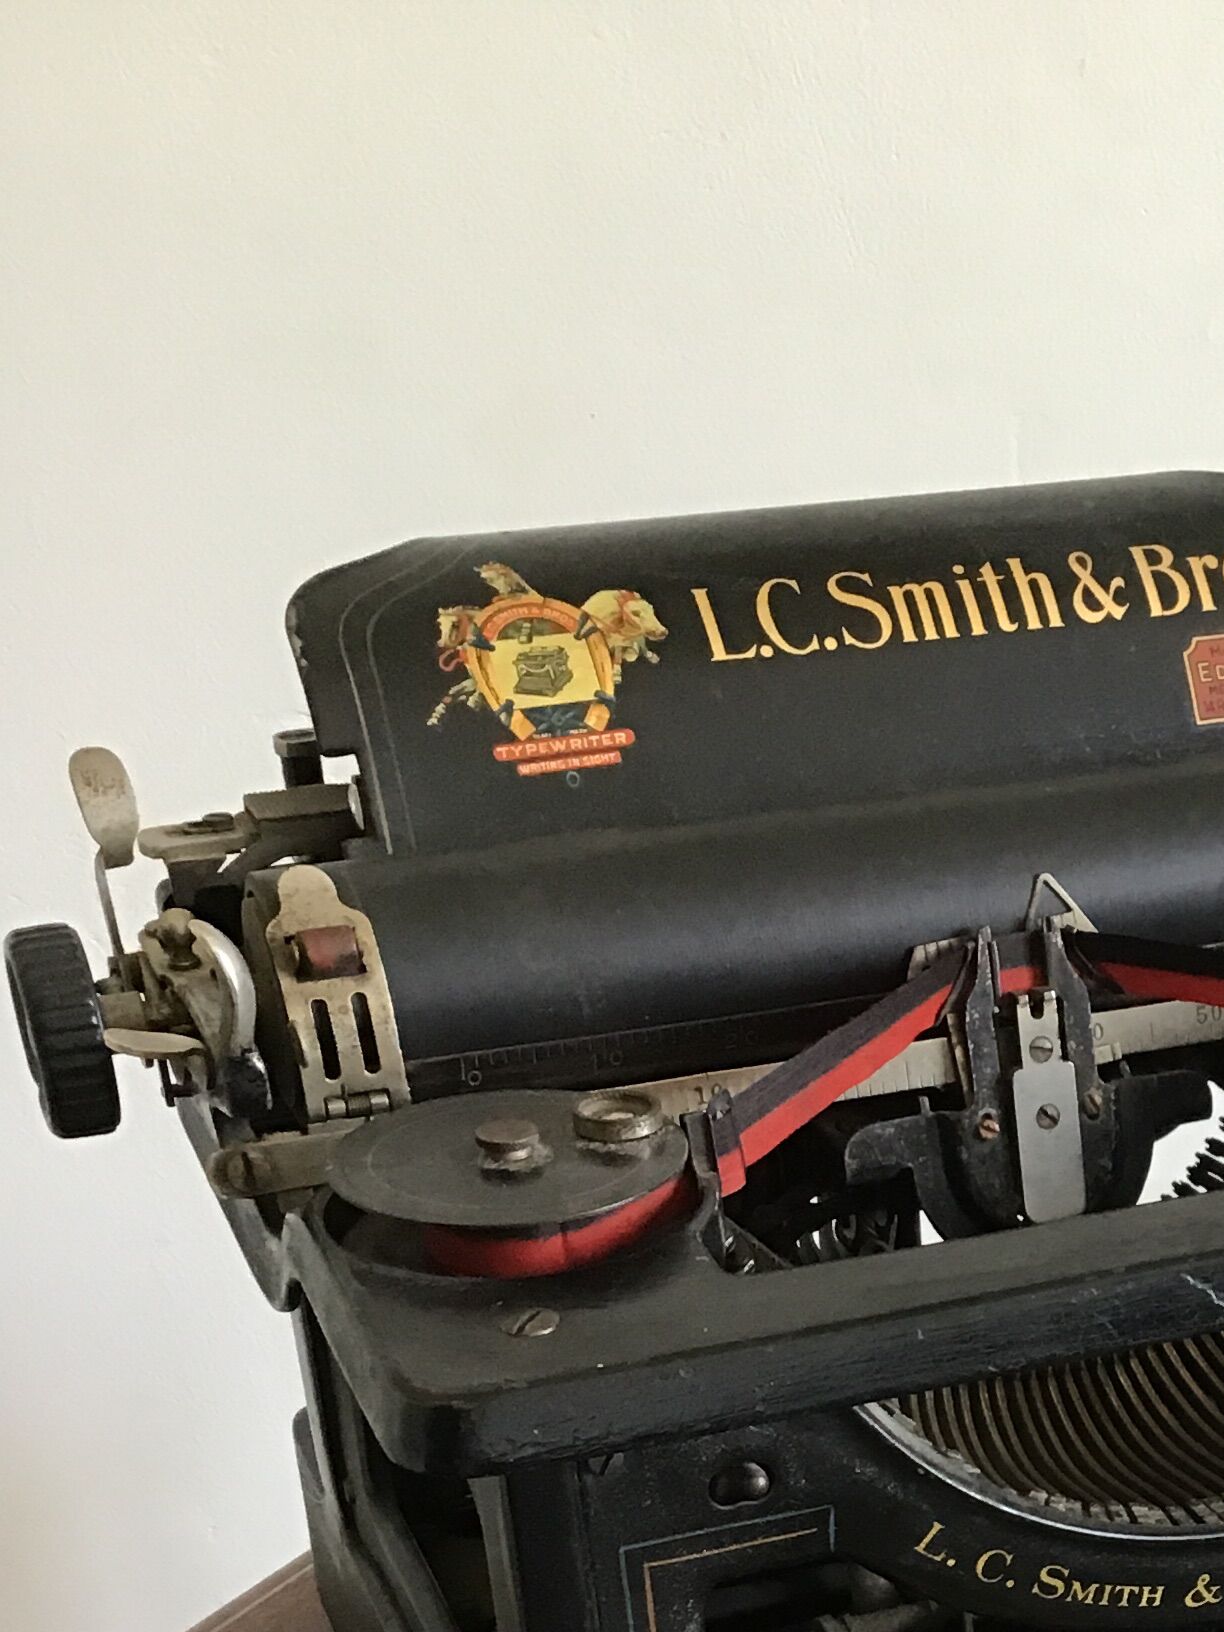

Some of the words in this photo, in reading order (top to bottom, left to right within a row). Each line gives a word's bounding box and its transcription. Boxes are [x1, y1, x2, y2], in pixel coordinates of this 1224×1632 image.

[495, 732, 627, 759] TYPEWRITER
[519, 758, 566, 774] WRITING
[1032, 1563, 1166, 1609] SMITH
[1184, 1571, 1222, 1609] &
